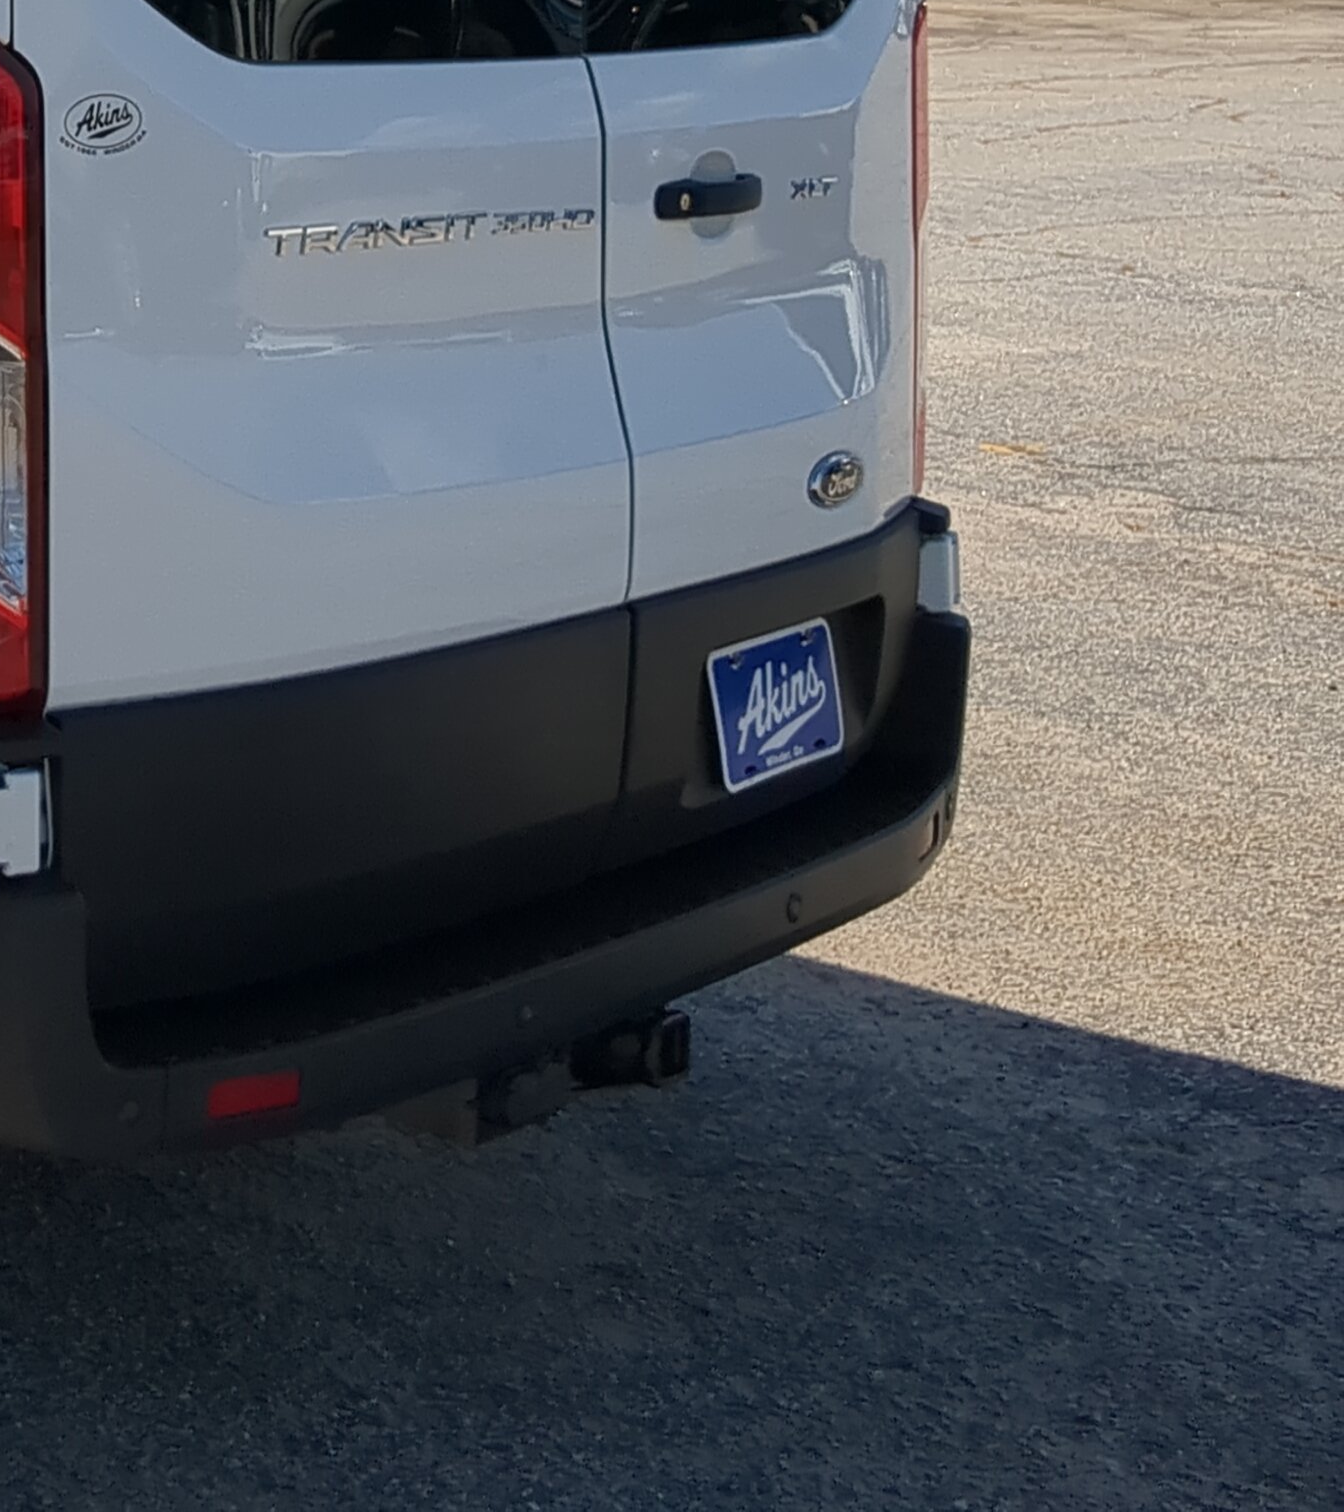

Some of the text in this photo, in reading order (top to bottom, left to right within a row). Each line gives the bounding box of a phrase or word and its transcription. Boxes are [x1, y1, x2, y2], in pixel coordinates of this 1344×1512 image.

[75, 100, 133, 139] Akins
[790, 175, 839, 199] XLT
[264, 208, 595, 256] TRANSIT 350HD
[738, 655, 826, 756] Akins
